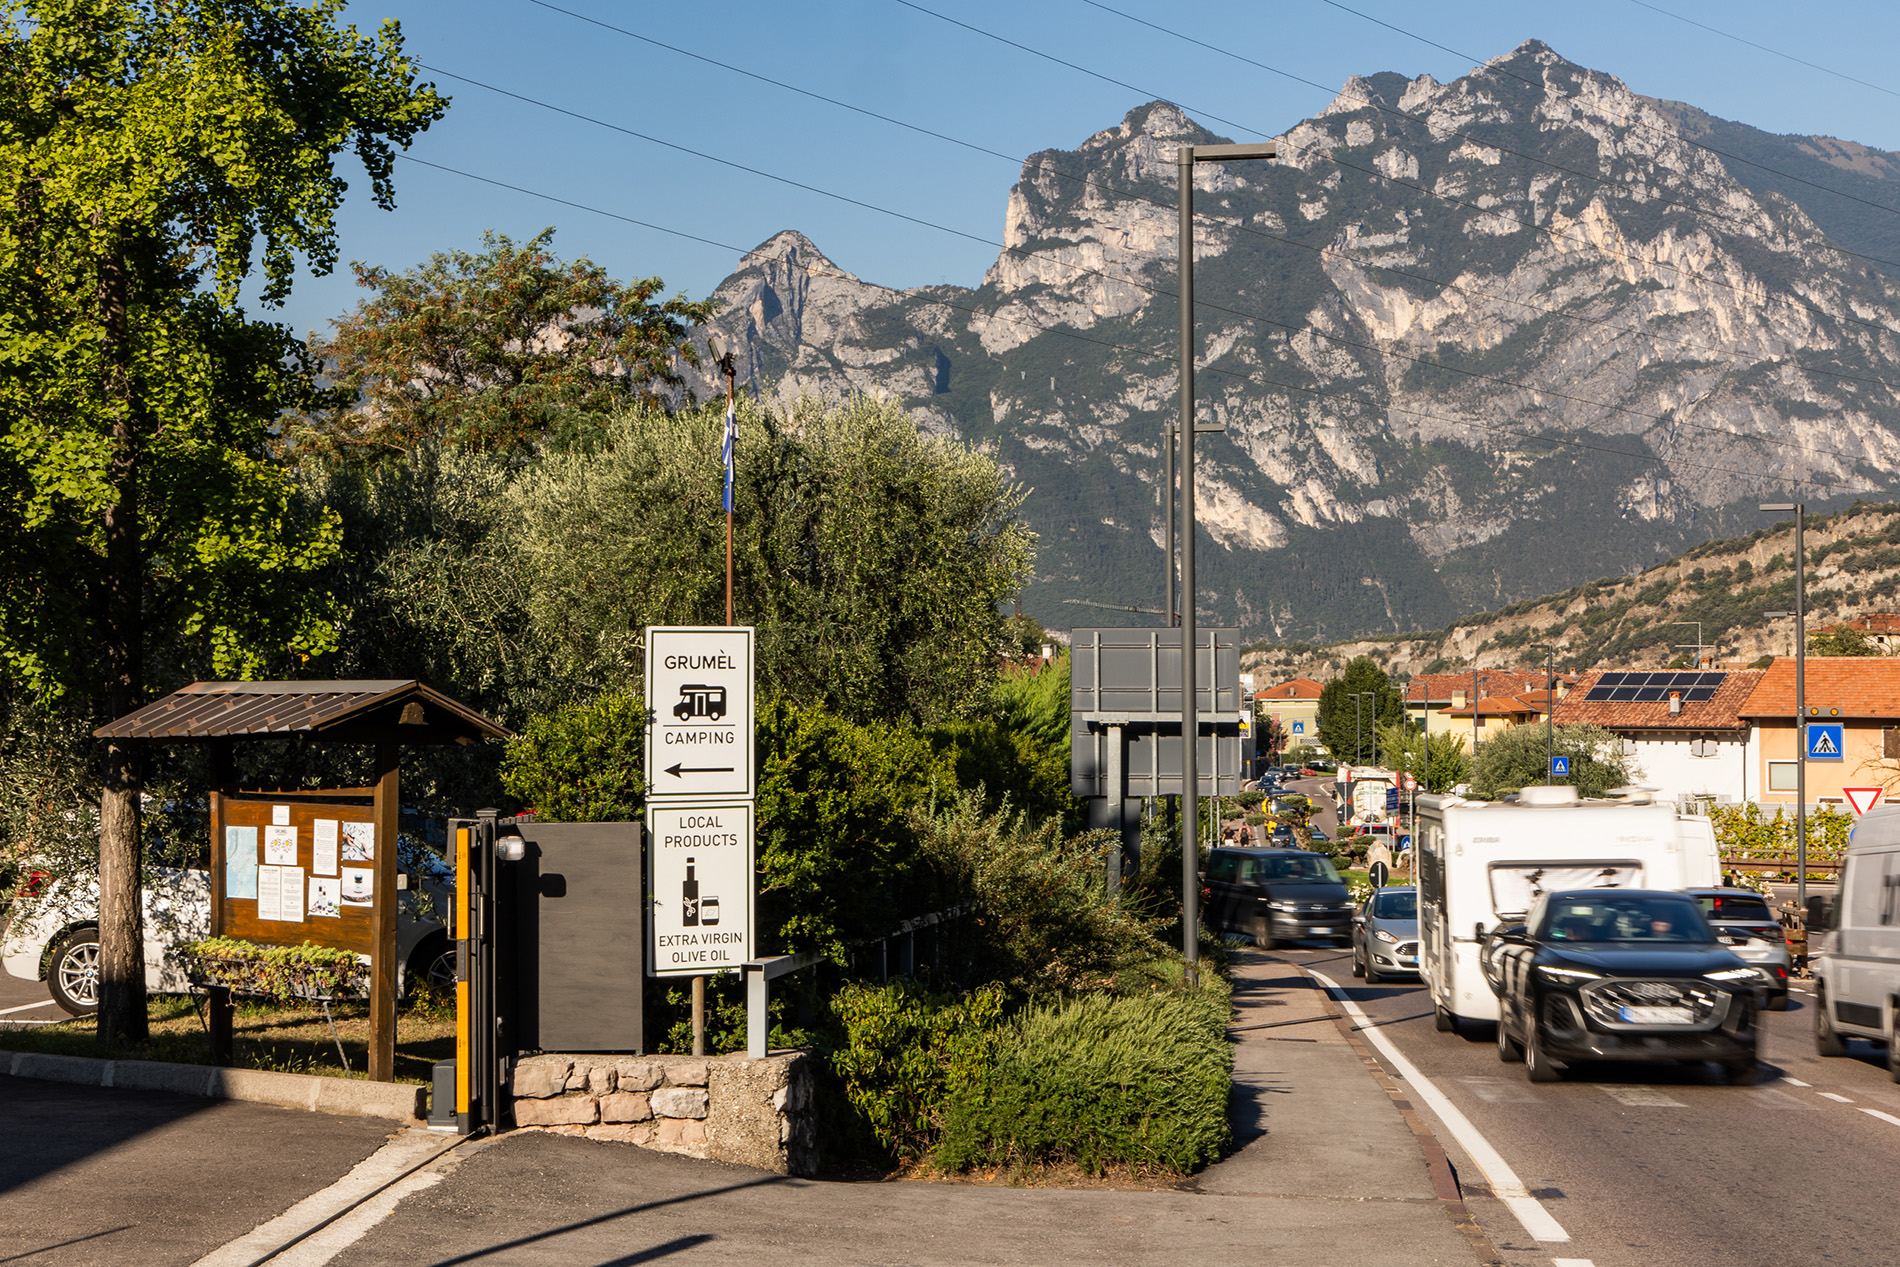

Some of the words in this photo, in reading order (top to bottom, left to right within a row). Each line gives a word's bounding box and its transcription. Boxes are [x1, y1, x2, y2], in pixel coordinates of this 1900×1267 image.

[664, 649, 737, 670] GRUMÈL
[665, 731, 735, 745] CAMPING
[679, 816, 723, 829] LOCAL
[664, 833, 738, 848] PRODUCTS
[659, 934, 699, 947] EXTRA
[701, 932, 743, 945] VIRGIN
[672, 950, 707, 963] OLIVE
[709, 949, 731, 961] OIL
